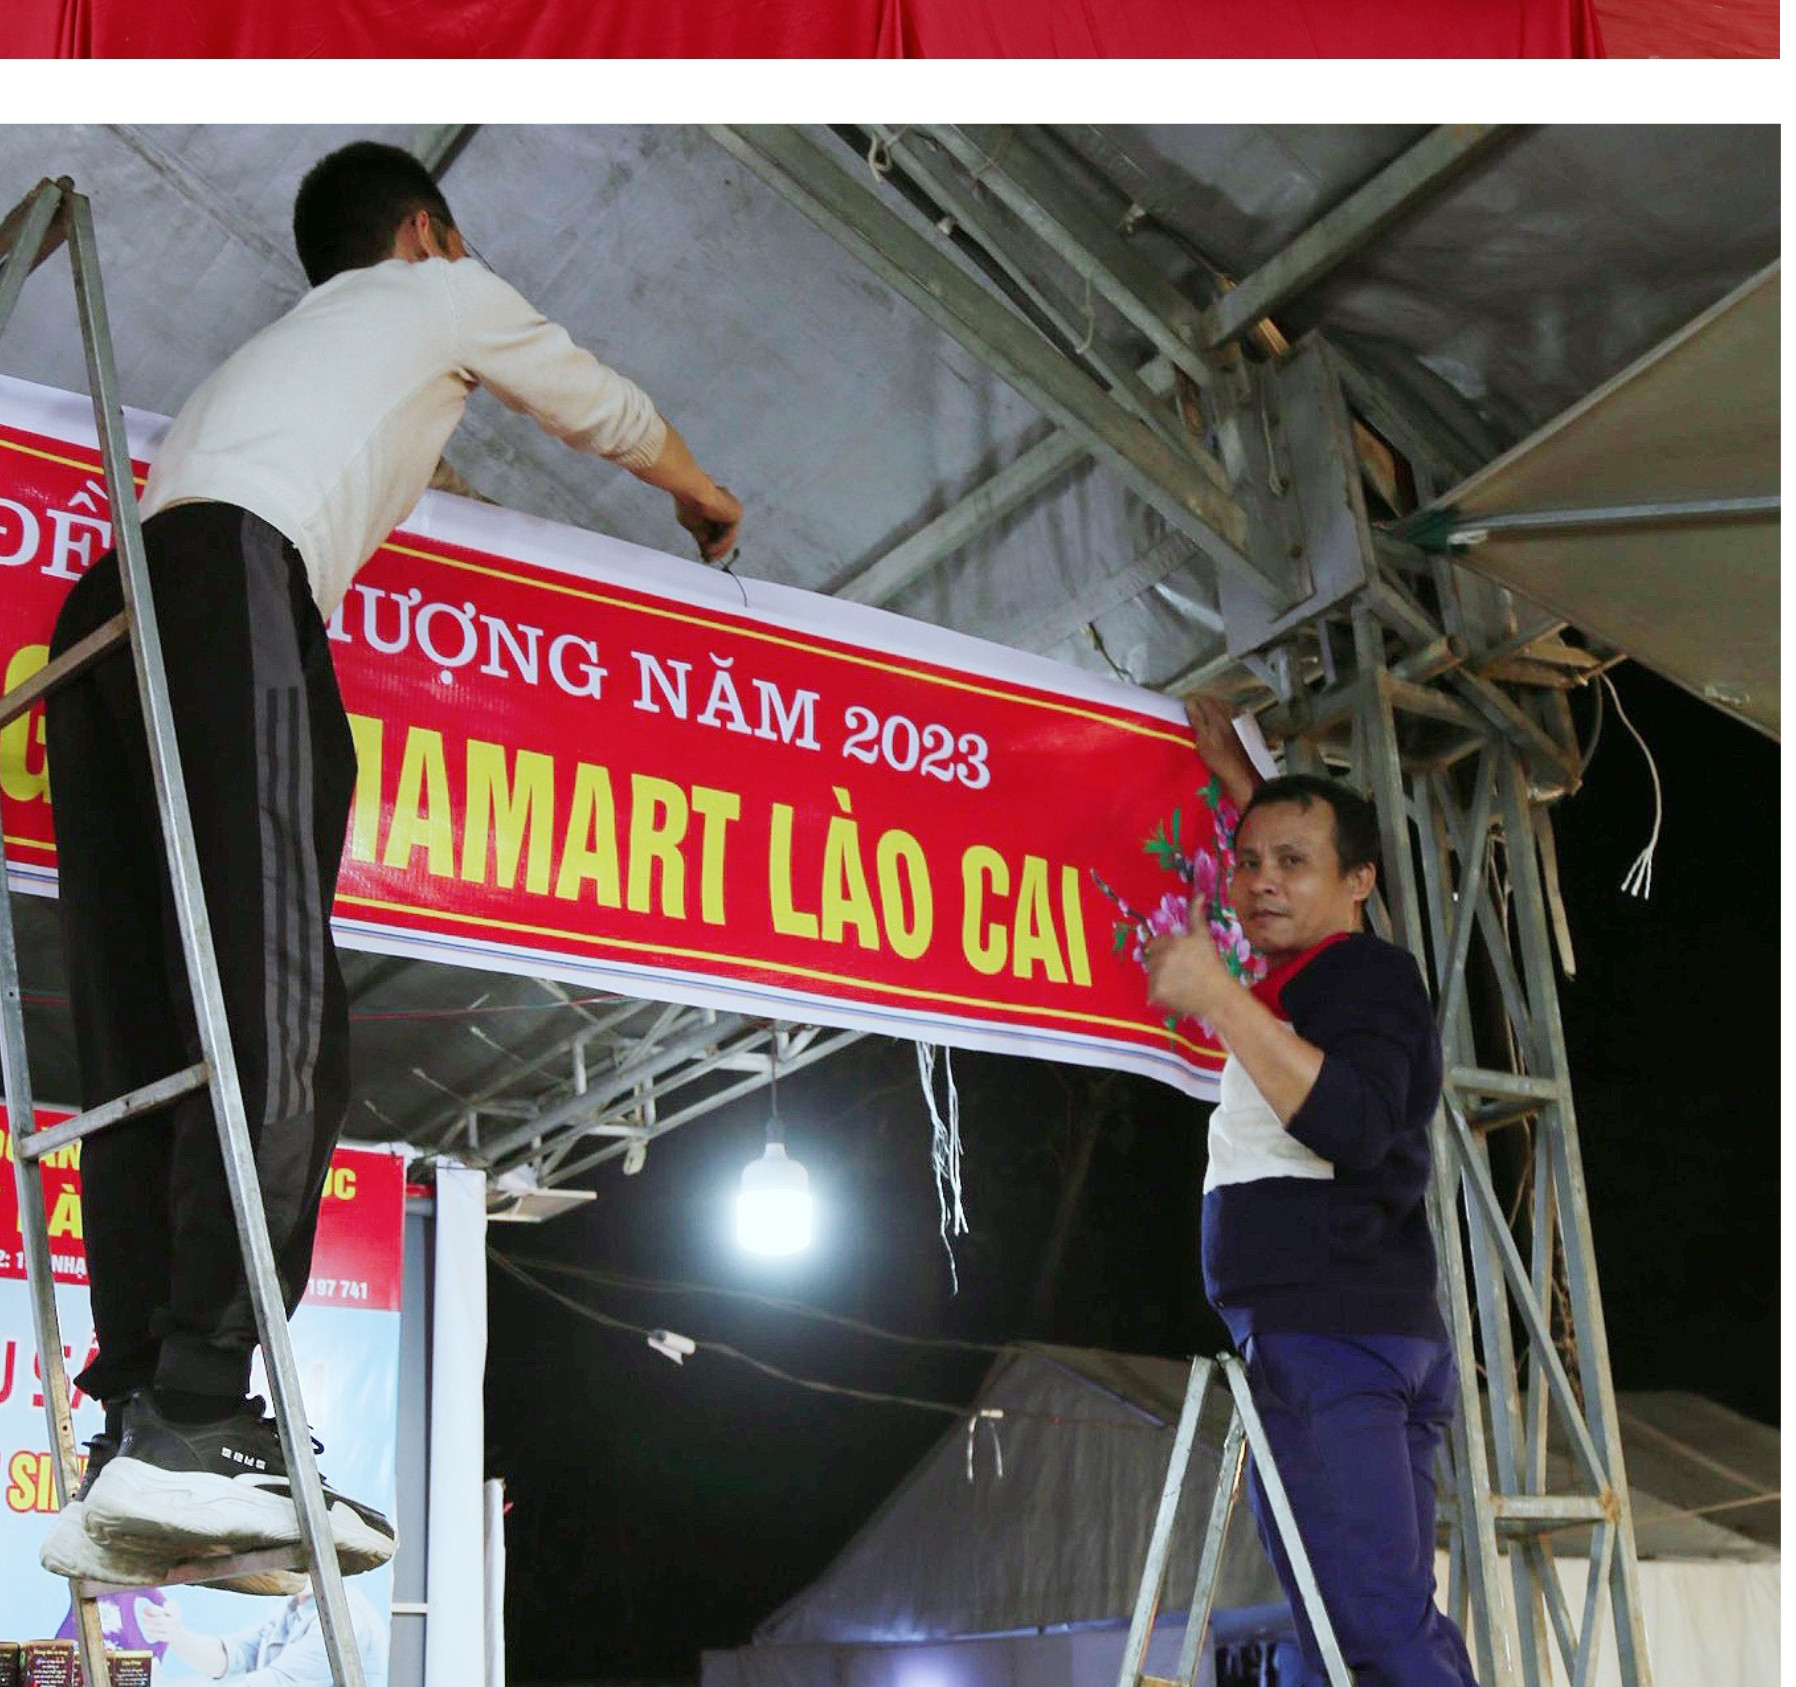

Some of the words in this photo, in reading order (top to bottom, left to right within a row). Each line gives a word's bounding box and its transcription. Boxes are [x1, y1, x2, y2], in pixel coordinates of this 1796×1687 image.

[630, 648, 822, 752] NĂM
[842, 705, 991, 790] 2023
[768, 782, 934, 962] LÀO
[960, 842, 1094, 990] CAI
[308, 1278, 337, 1299] 197
[340, 1281, 369, 1301] 741
